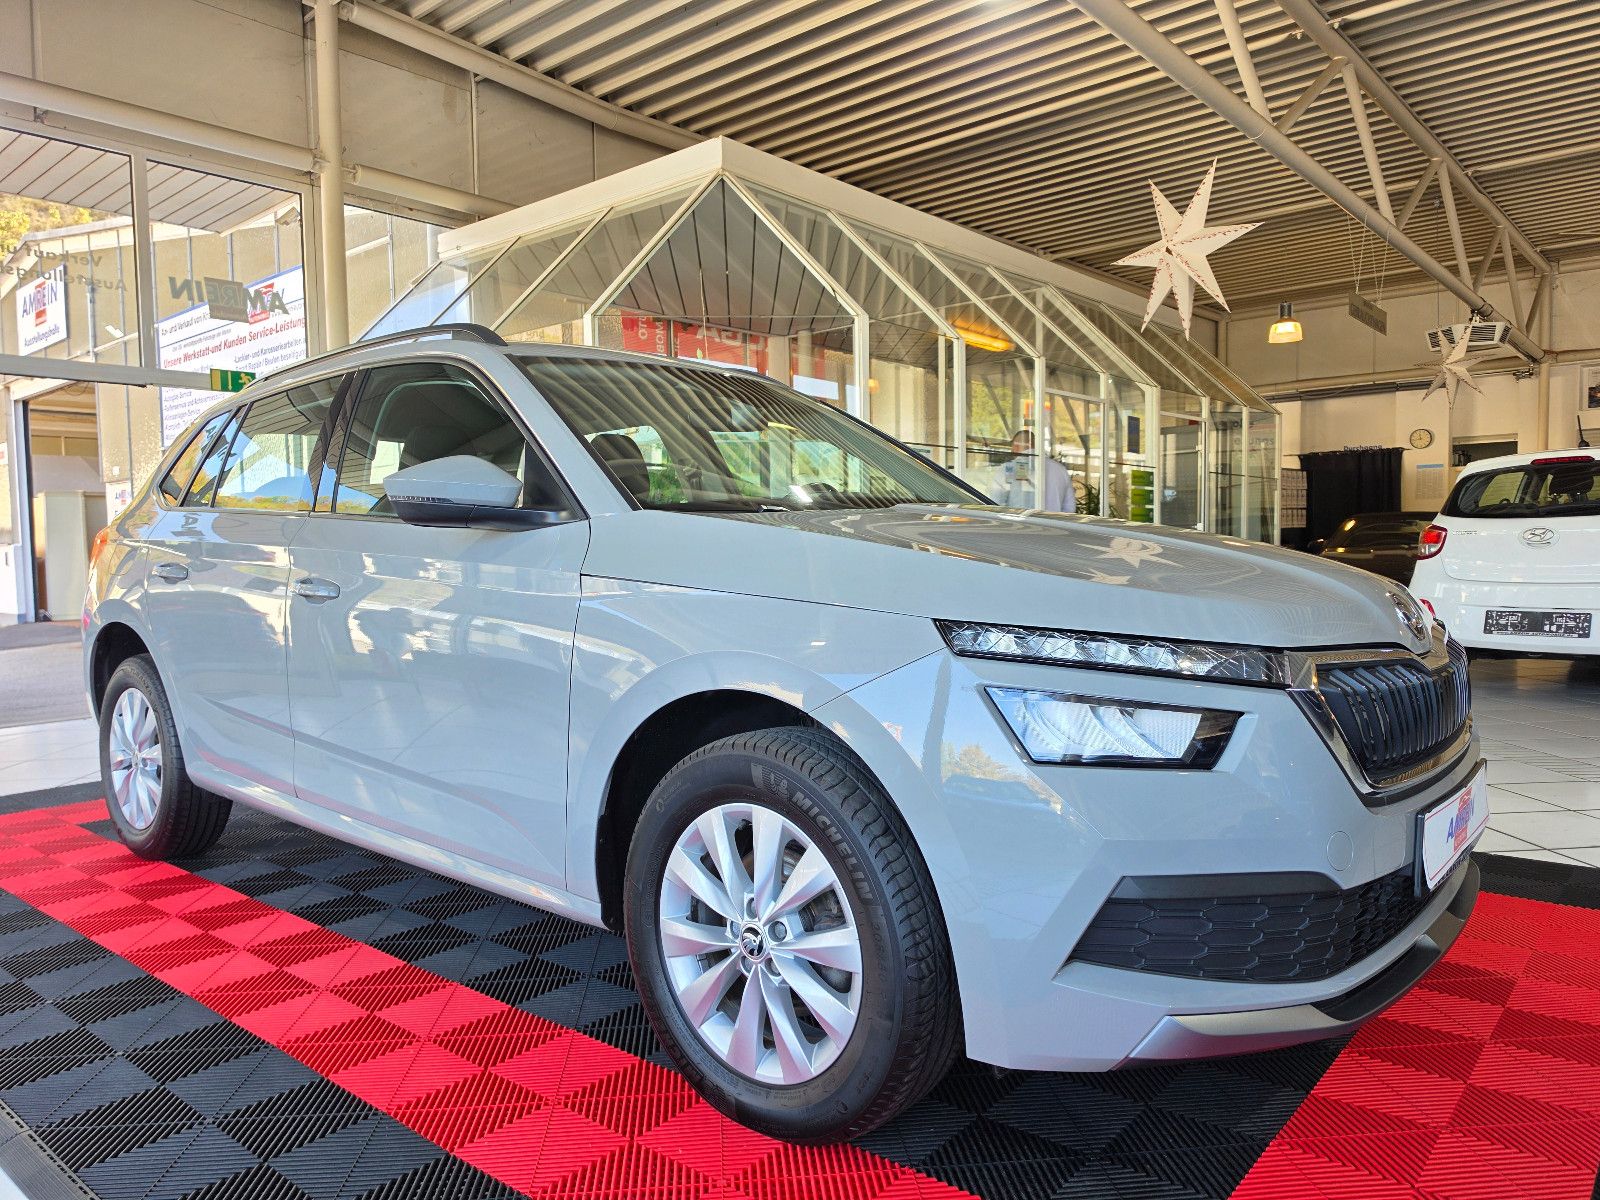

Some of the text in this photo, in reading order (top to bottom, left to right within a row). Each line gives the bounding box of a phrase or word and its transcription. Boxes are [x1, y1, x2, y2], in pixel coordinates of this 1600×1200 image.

[22, 283, 58, 318] AMREIN
[224, 335, 247, 351] Kunden
[791, 791, 873, 902] MICHELIN
